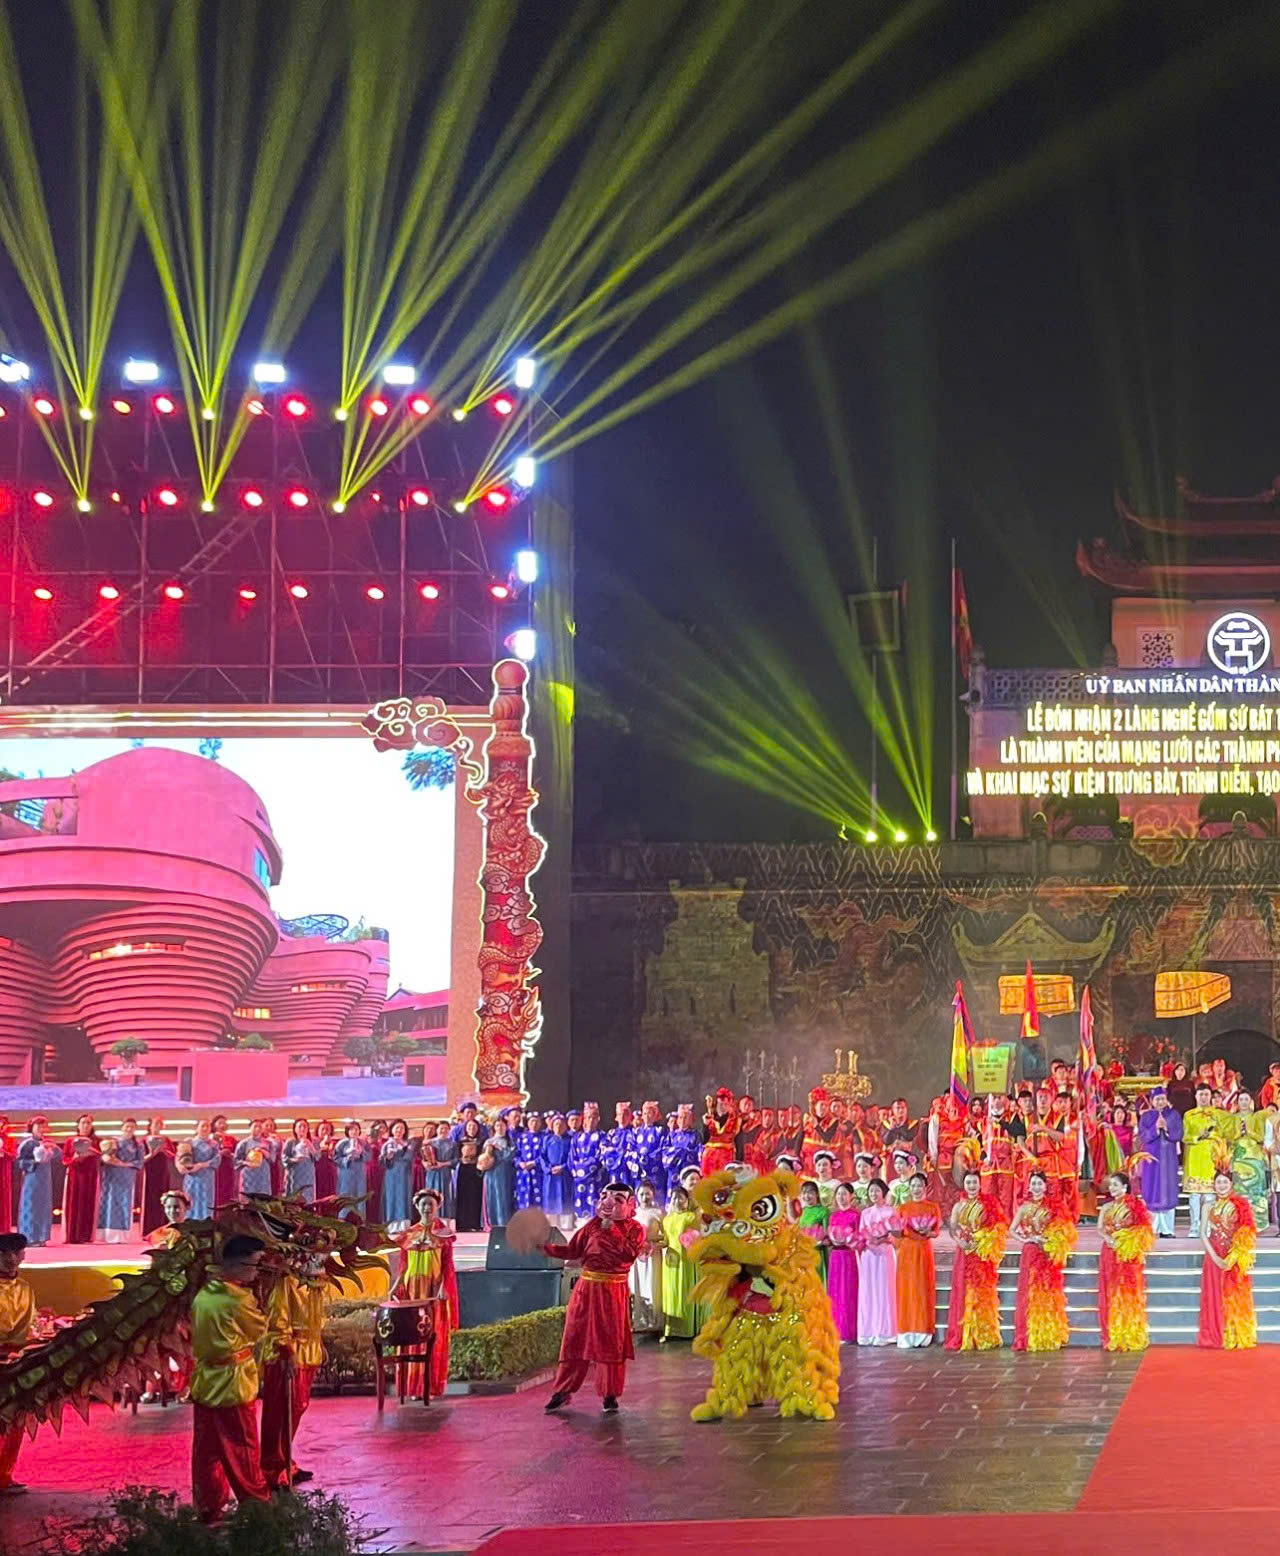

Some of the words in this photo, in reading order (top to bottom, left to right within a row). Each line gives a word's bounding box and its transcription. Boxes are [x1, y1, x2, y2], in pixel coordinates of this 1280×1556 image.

[1113, 679, 1146, 693] BAN
[1200, 675, 1233, 693] DÂN
[1074, 704, 1111, 735] NHẬN
[1113, 708, 1122, 732] 2
[1125, 704, 1160, 732] LÀNG
[1198, 701, 1228, 731] GỐM
[1229, 703, 1249, 731] SỨ
[1000, 735, 1019, 763] LÀ
[1095, 733, 1120, 763] CỦA
[1121, 740, 1161, 766] MẠNG
[1194, 736, 1221, 763] CÁC
[966, 767, 984, 795] VÀ
[985, 771, 1018, 795] KHAI
[1051, 769, 1072, 798] SỰ
[1074, 767, 1105, 798] KIỆN
[1107, 769, 1153, 795] TRƯNG
[1255, 770, 1280, 796] TẠO
